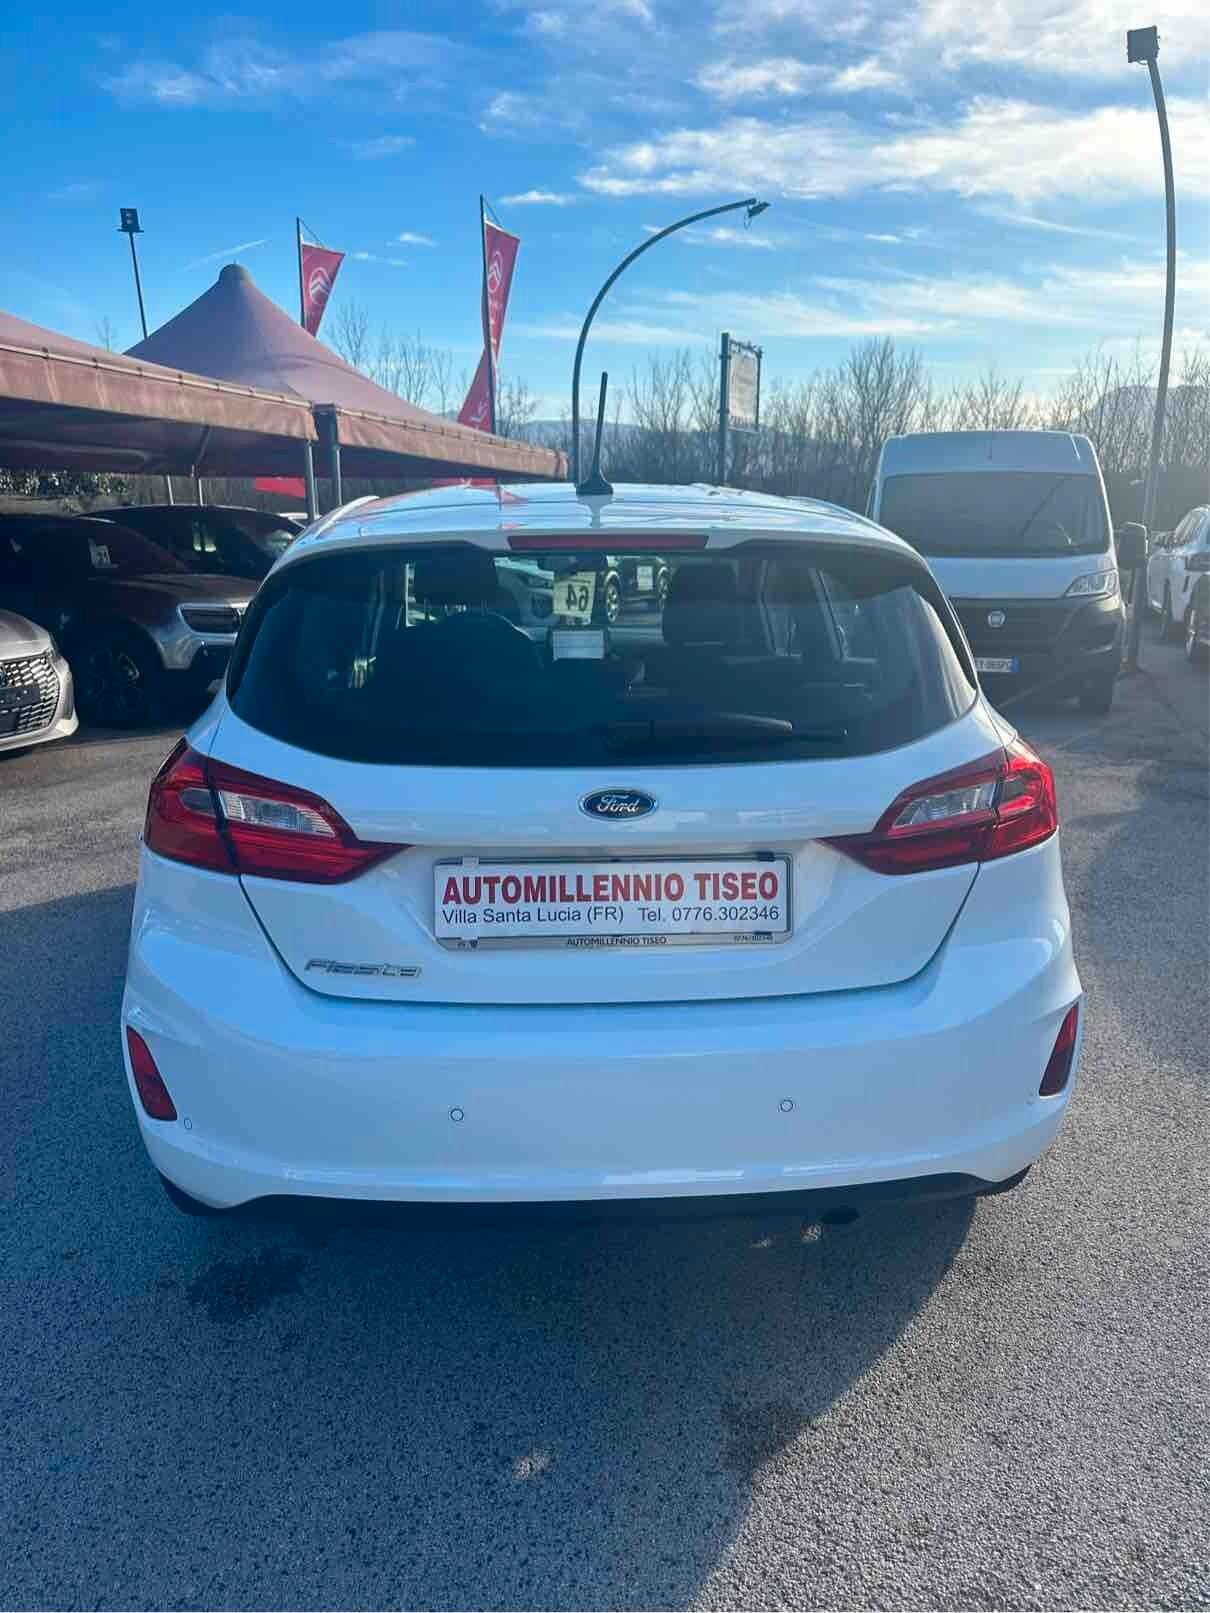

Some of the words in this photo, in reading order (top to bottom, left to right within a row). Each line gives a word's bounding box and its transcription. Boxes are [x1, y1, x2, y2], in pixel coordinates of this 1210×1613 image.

[596, 794, 641, 812] Ford
[441, 872, 685, 905] AUTOMILLENNIO
[693, 871, 780, 902] TISEO
[442, 908, 478, 924] Villa
[482, 907, 532, 923] Santa
[536, 906, 582, 922] Lucia
[586, 905, 624, 924] (FR)
[638, 906, 664, 923] Tel.
[672, 905, 780, 922] 0776.302346
[566, 936, 641, 946] AUTOMILLENNIO
[642, 935, 668, 945] TISEO
[304, 958, 423, 978] Fiesta
